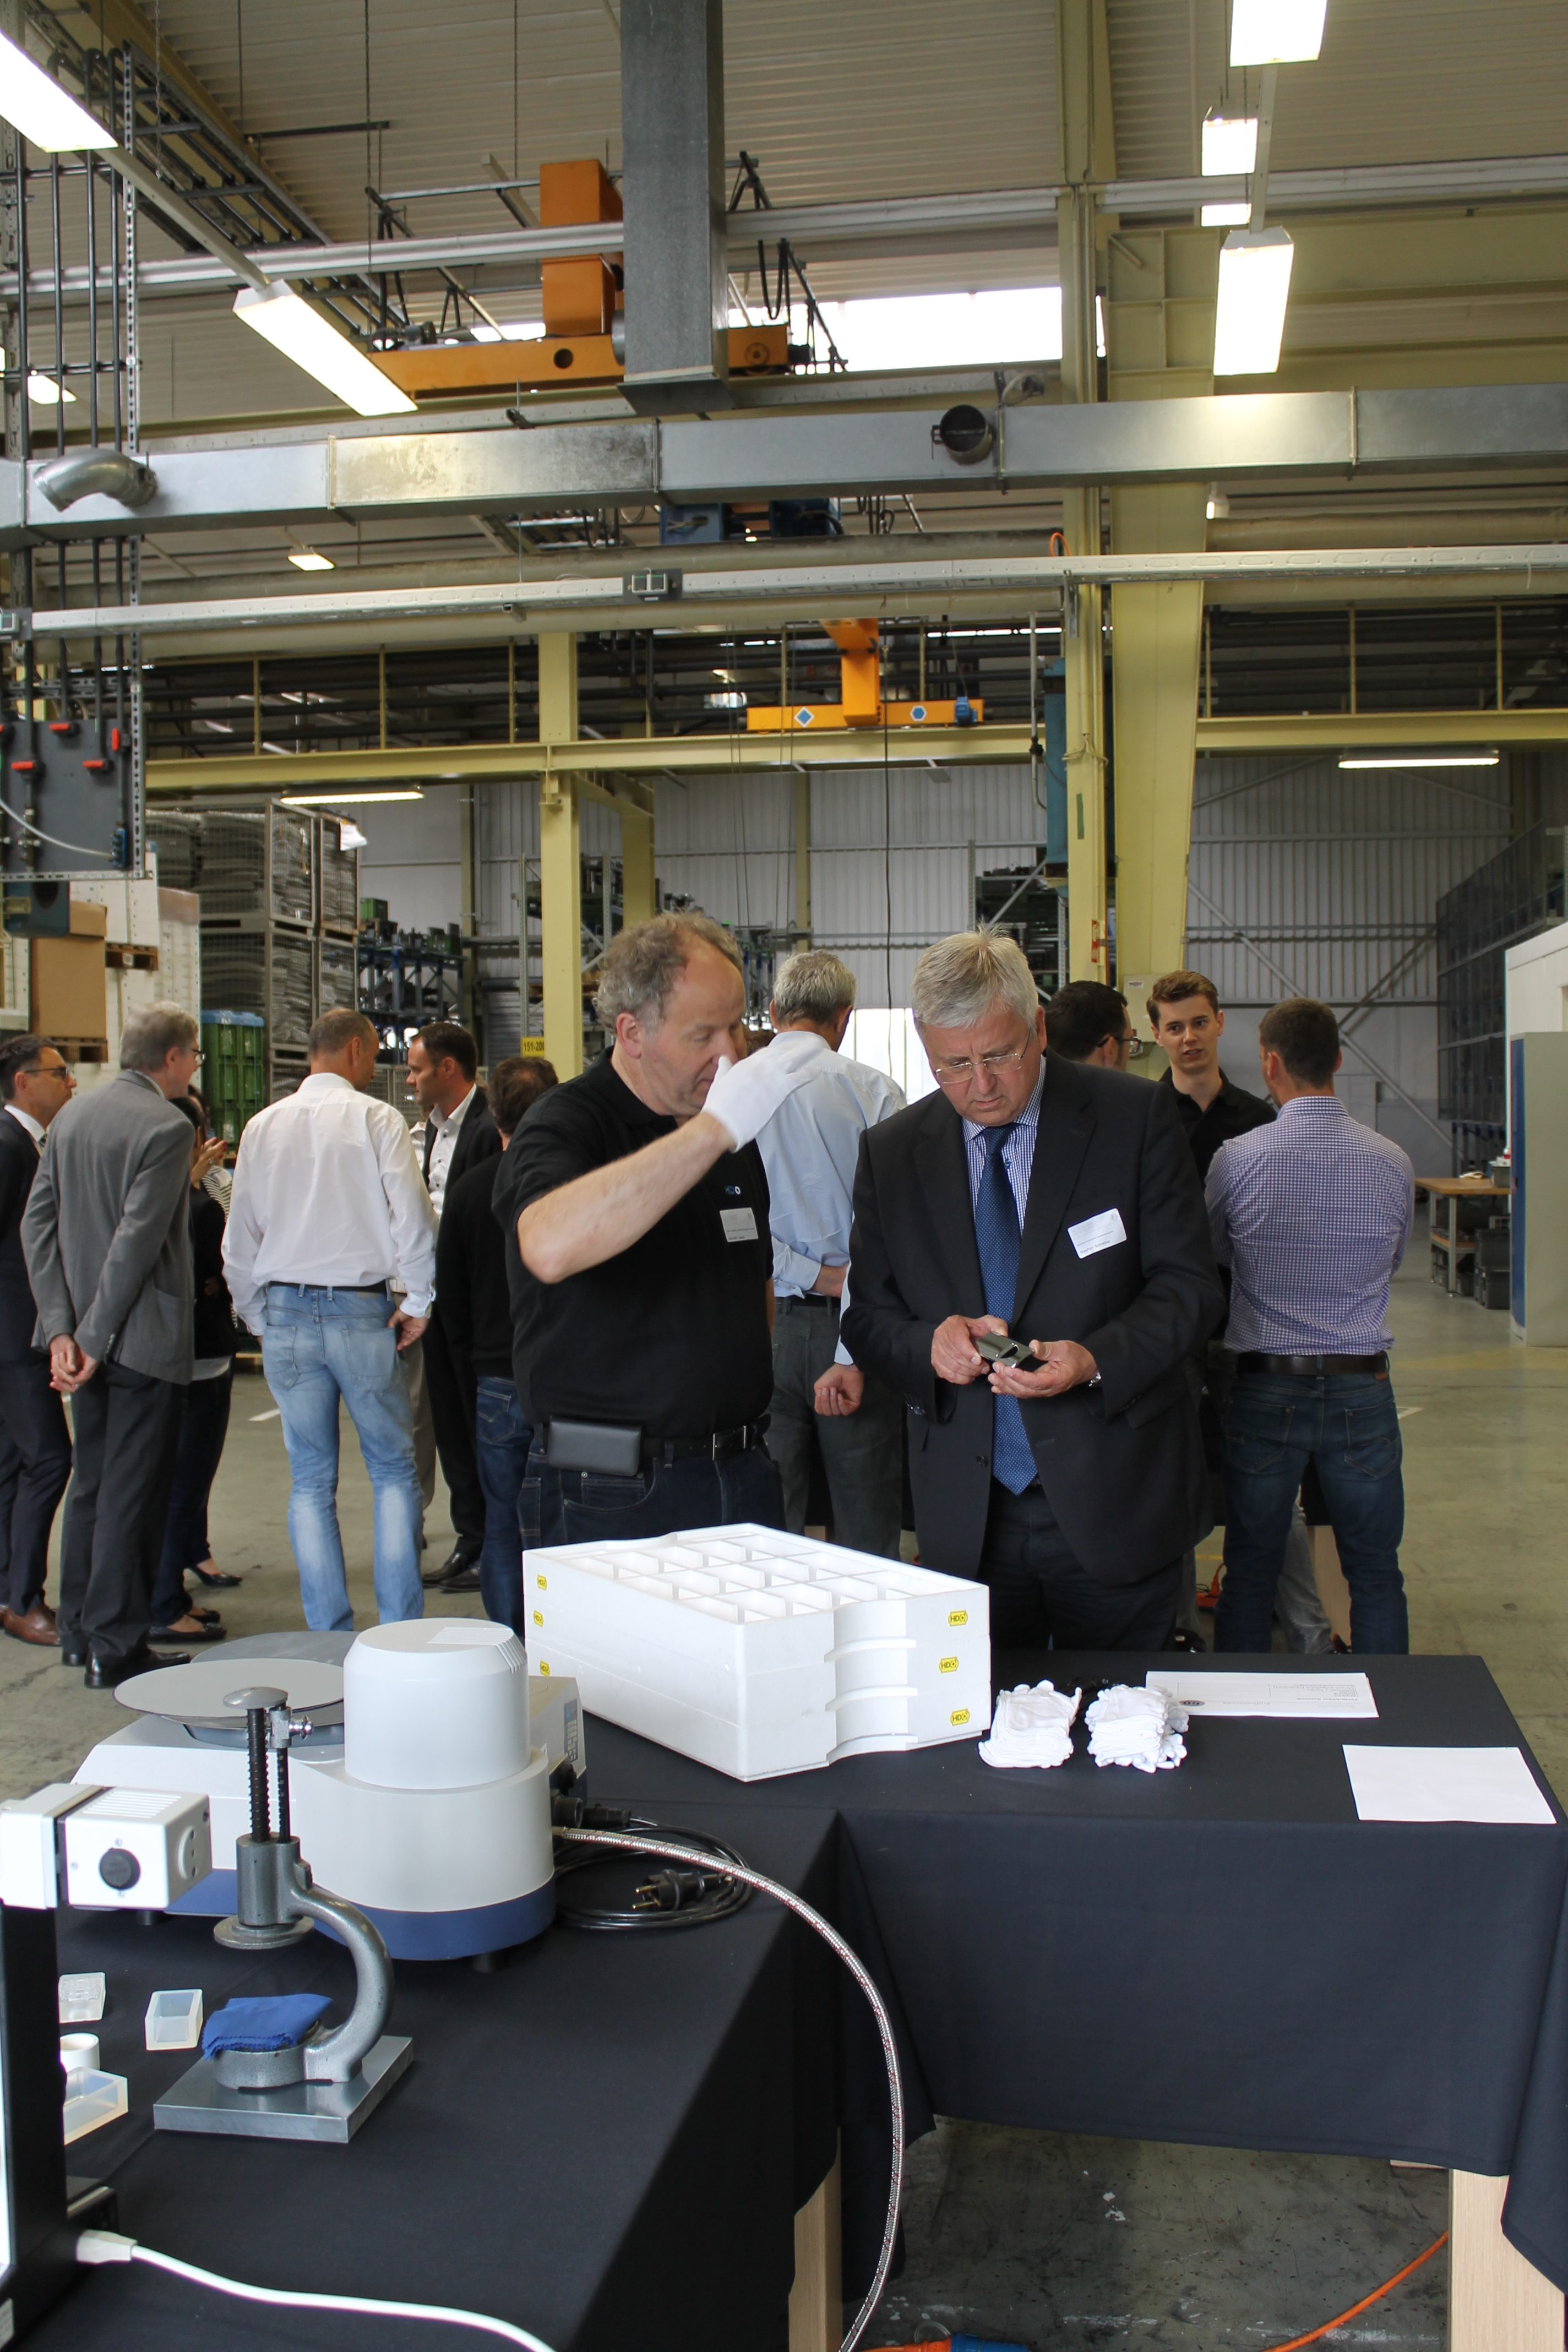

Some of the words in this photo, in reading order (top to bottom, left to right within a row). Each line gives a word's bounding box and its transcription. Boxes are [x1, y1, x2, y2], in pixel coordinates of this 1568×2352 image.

[950, 1614, 966, 1623] HDO
[941, 1660, 957, 1669] HDO
[952, 1712, 968, 1722] HDO
